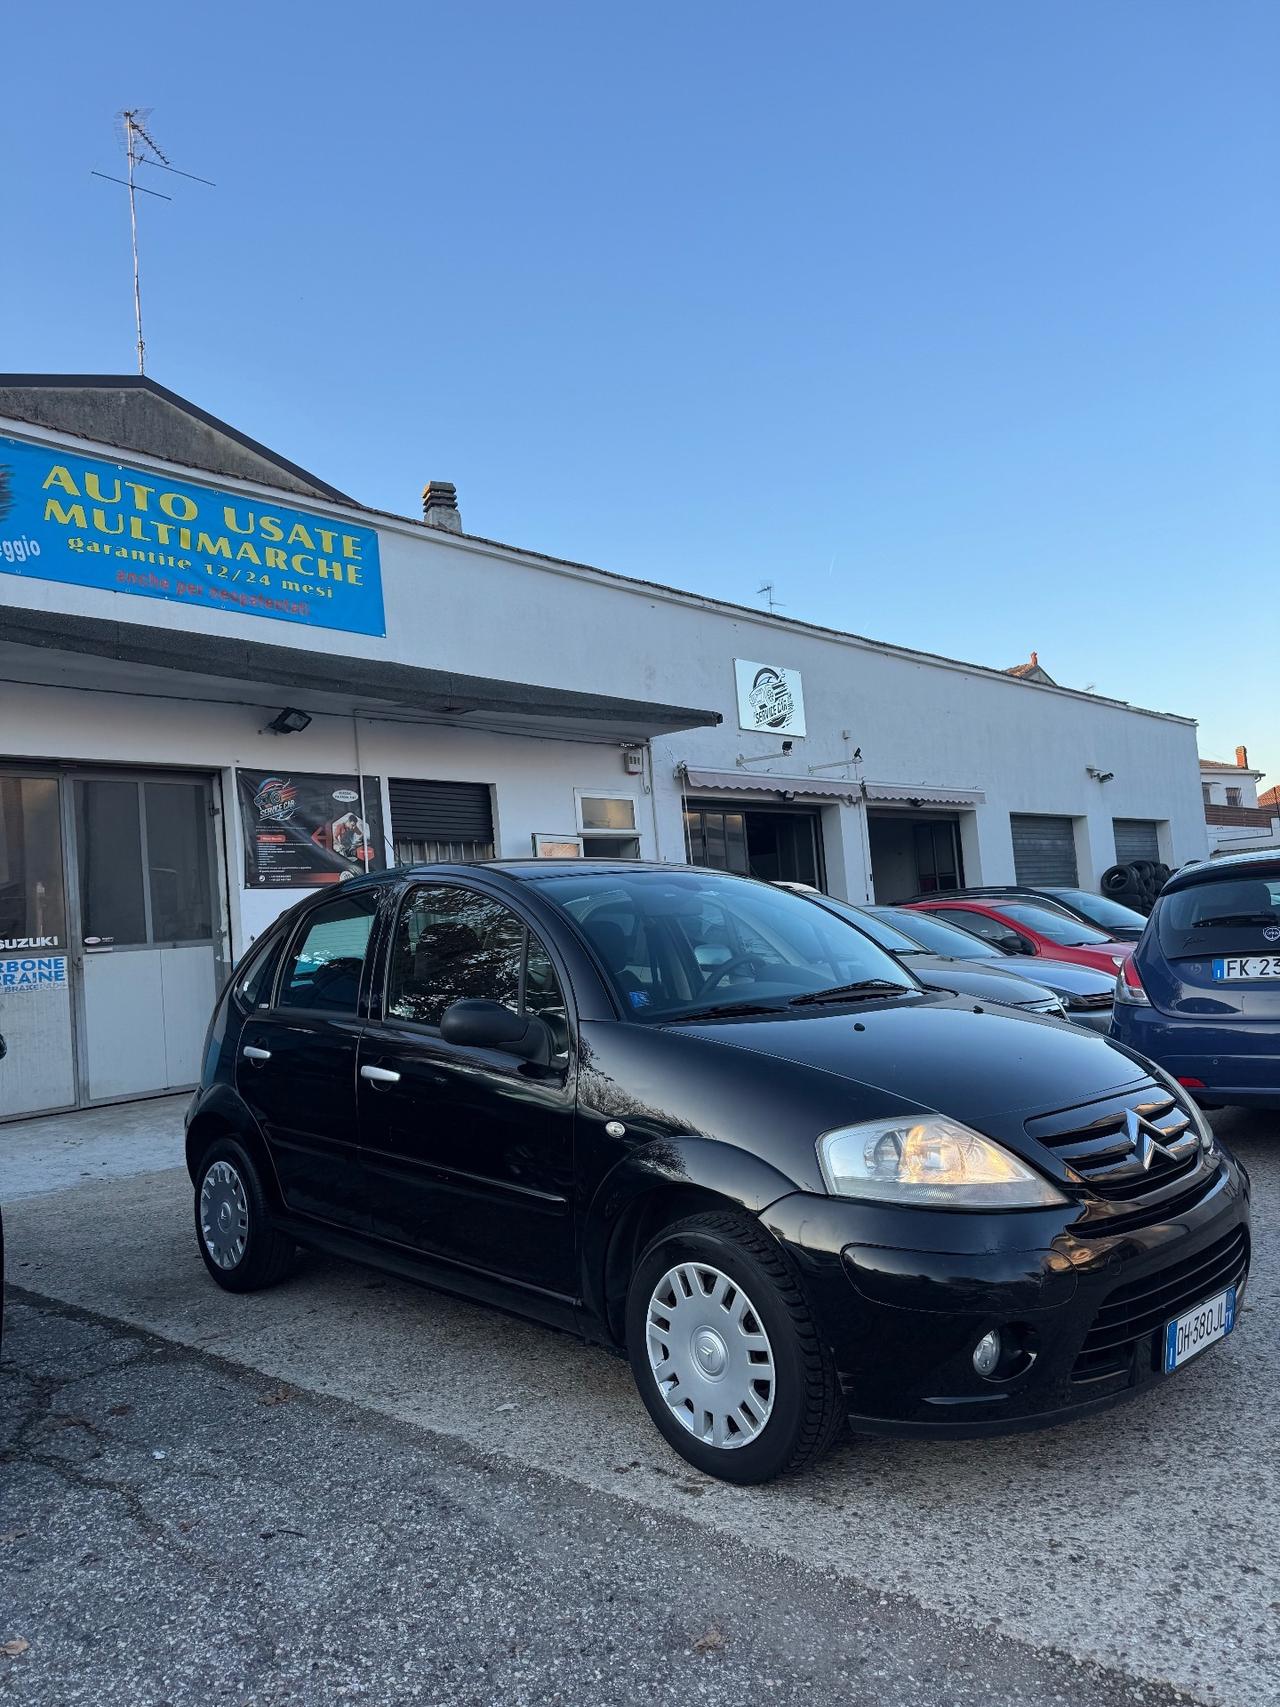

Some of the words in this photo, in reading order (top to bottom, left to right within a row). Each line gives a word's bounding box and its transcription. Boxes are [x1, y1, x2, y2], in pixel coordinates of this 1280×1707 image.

[42, 465, 199, 521] AUTO
[223, 507, 364, 561] USATE
[0, 535, 41, 563] ggio
[44, 498, 364, 587] MULTIMARCHE
[67, 536, 192, 570] garantite
[204, 563, 272, 587] 12/24
[281, 578, 334, 599] mesi
[116, 569, 169, 591] anche
[176, 581, 206, 597] per
[755, 705, 777, 724] SERVICE
[777, 698, 788, 713] CAR
[259, 803, 282, 818] SERVICE
[283, 800, 295, 811] CAR
[0, 970, 65, 986] RAINE
